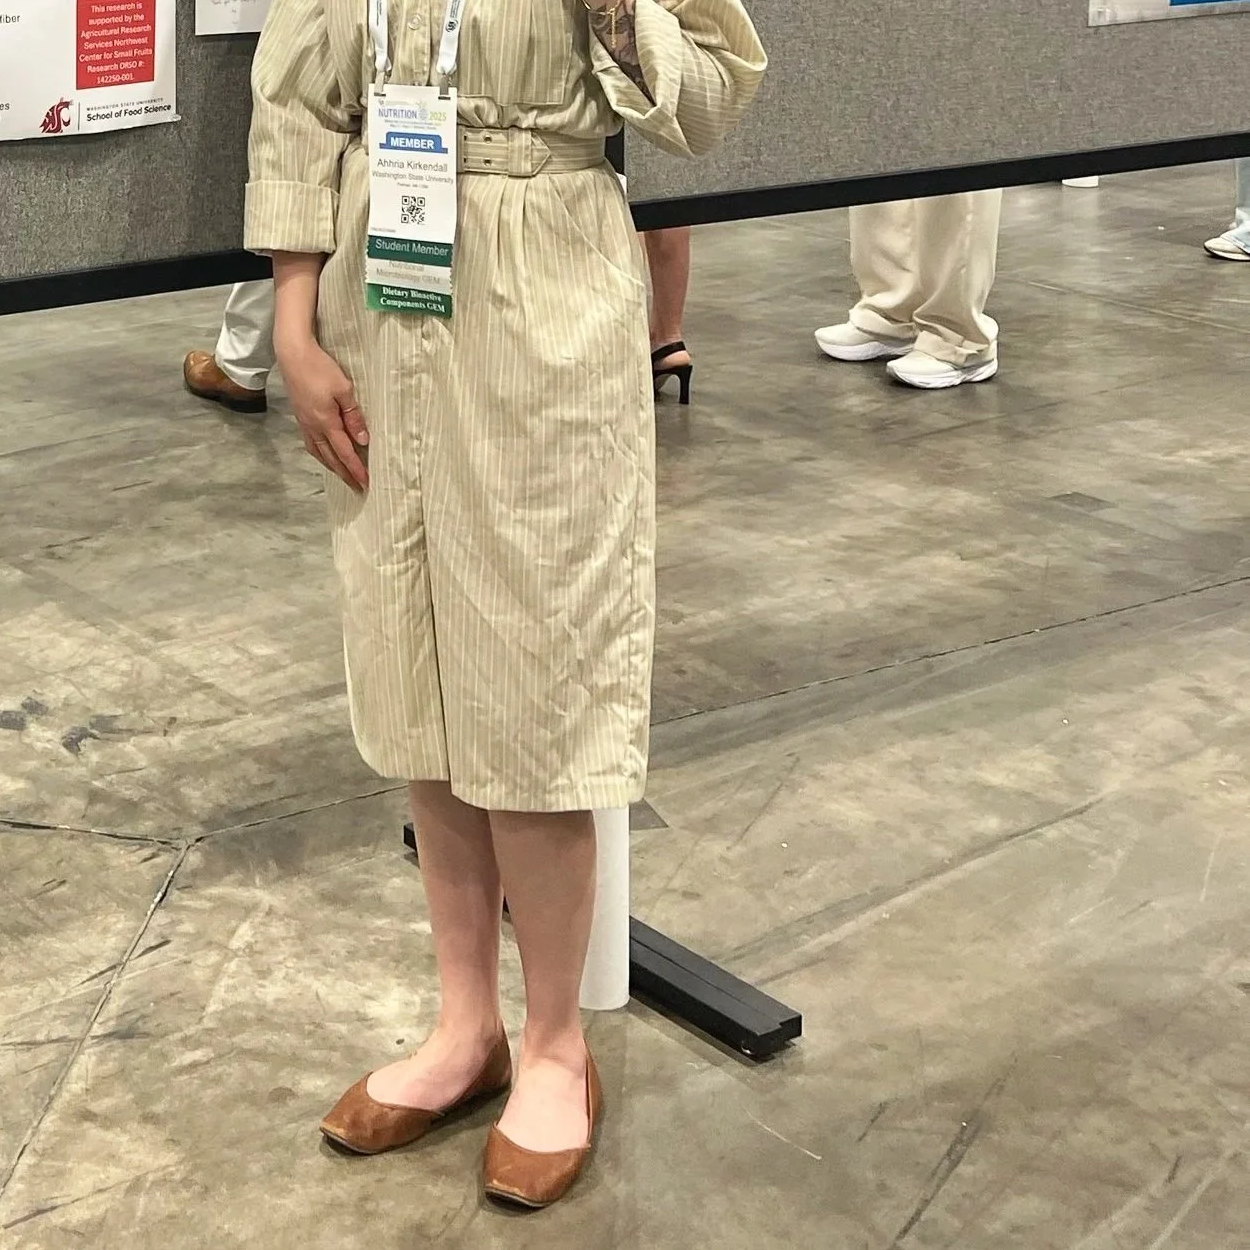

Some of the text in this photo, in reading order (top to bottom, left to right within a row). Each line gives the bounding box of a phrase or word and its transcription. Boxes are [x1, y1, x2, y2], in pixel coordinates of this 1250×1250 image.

[86, 110, 113, 122] School
[113, 108, 122, 118] of
[123, 106, 143, 116] Food
[143, 103, 172, 114] Science
[378, 108, 417, 119] NUTRITION
[390, 136, 434, 149] MEMBER
[377, 158, 448, 172] Ahhria Kirkendall
[372, 171, 406, 180] Washington
[426, 174, 454, 184] University
[375, 239, 448, 256] Student Member
[382, 287, 442, 302] Dietary Bioactive
[380, 298, 446, 312] Components GEM
